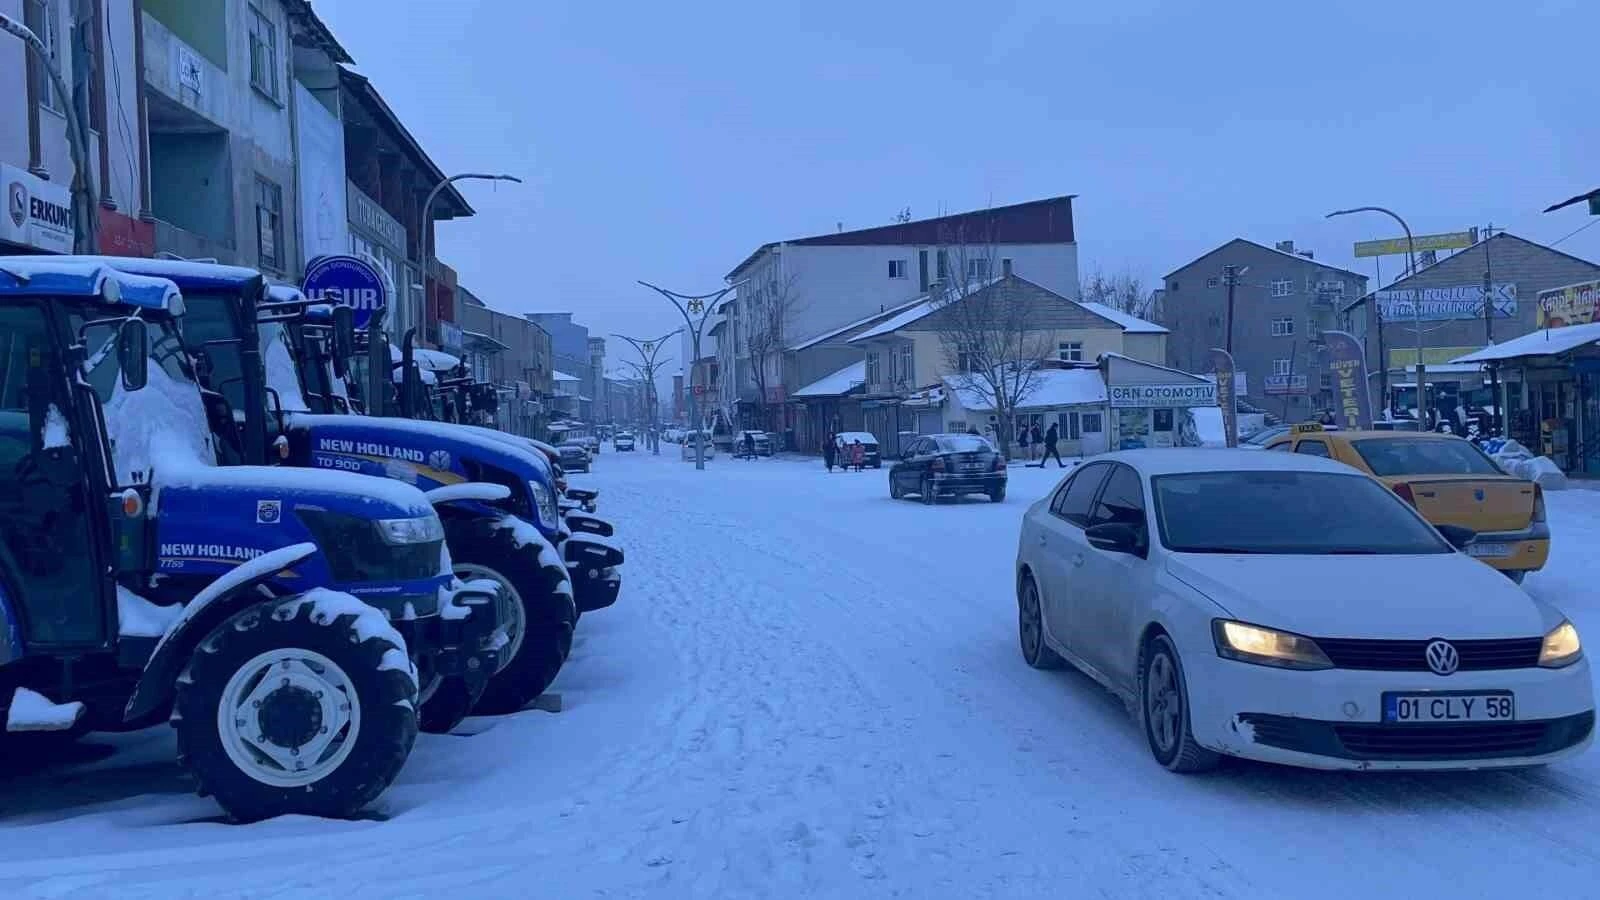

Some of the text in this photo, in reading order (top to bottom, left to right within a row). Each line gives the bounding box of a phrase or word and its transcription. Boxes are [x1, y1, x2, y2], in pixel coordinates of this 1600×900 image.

[320, 438, 424, 462] NEW HOLLAND
[317, 456, 333, 467] TD
[161, 543, 194, 556] NEW
[1399, 699, 1419, 719] 01
[1430, 698, 1474, 719] CLY
[1486, 697, 1511, 718] 58
